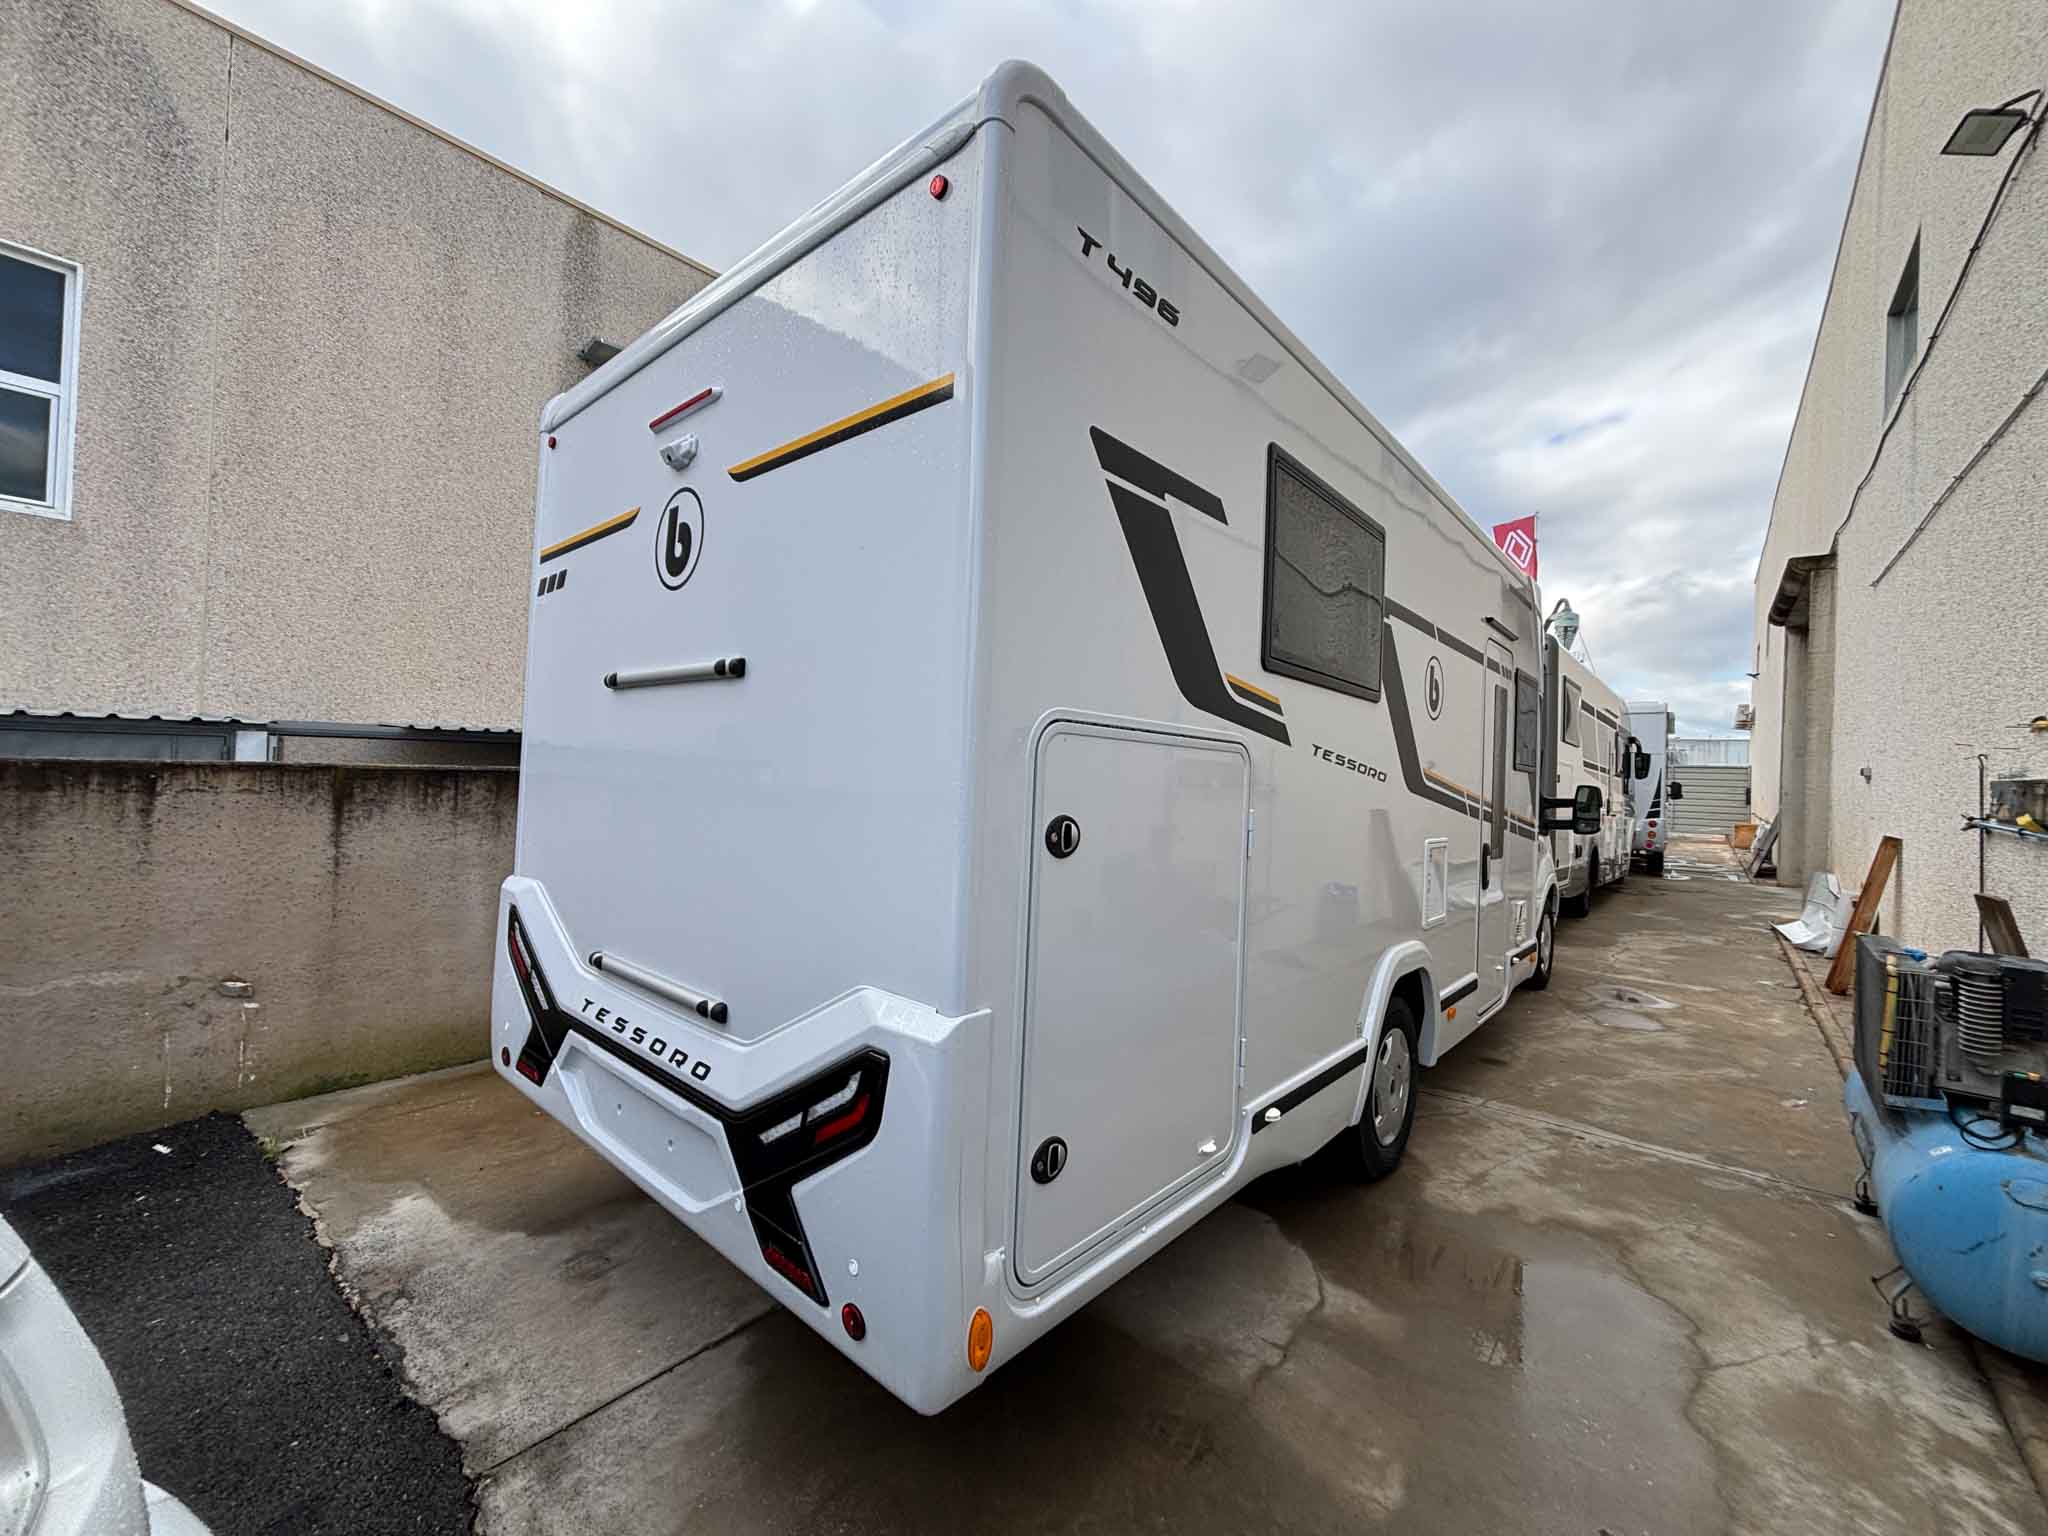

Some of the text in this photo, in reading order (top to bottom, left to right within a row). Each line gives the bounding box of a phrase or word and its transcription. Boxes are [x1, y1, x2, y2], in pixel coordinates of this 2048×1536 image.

[1077, 226, 1180, 327] T 496
[665, 505, 692, 578] b
[1429, 665, 1440, 713] b
[1311, 743, 1388, 783] TESSORO
[581, 998, 712, 1081] TESSORO
